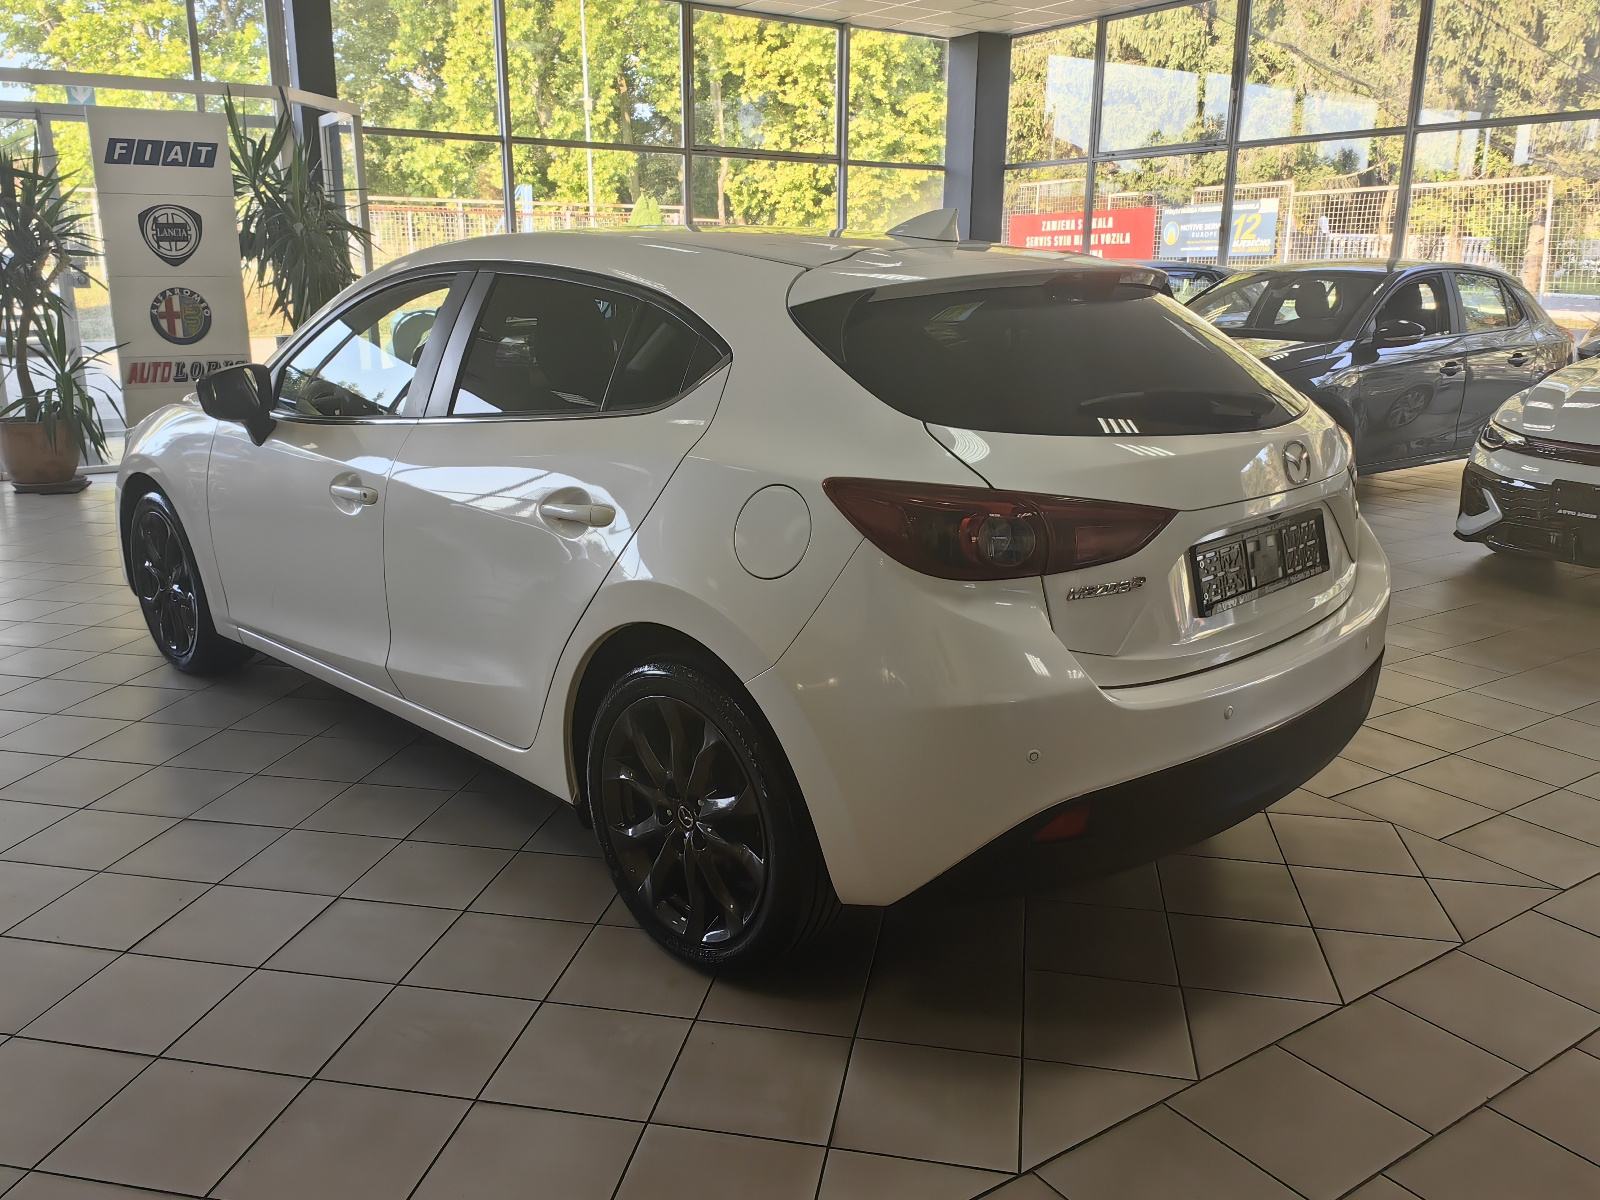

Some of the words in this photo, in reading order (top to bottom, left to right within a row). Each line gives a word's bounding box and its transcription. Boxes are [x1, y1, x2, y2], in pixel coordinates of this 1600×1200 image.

[112, 142, 212, 164] FIAT
[156, 227, 188, 237] LANCIA
[1078, 217, 1113, 230] SKALA
[1233, 213, 1262, 240] 12
[1026, 235, 1052, 248] SERVIS
[1100, 231, 1131, 244] VOZILA
[128, 361, 172, 384] AUTO
